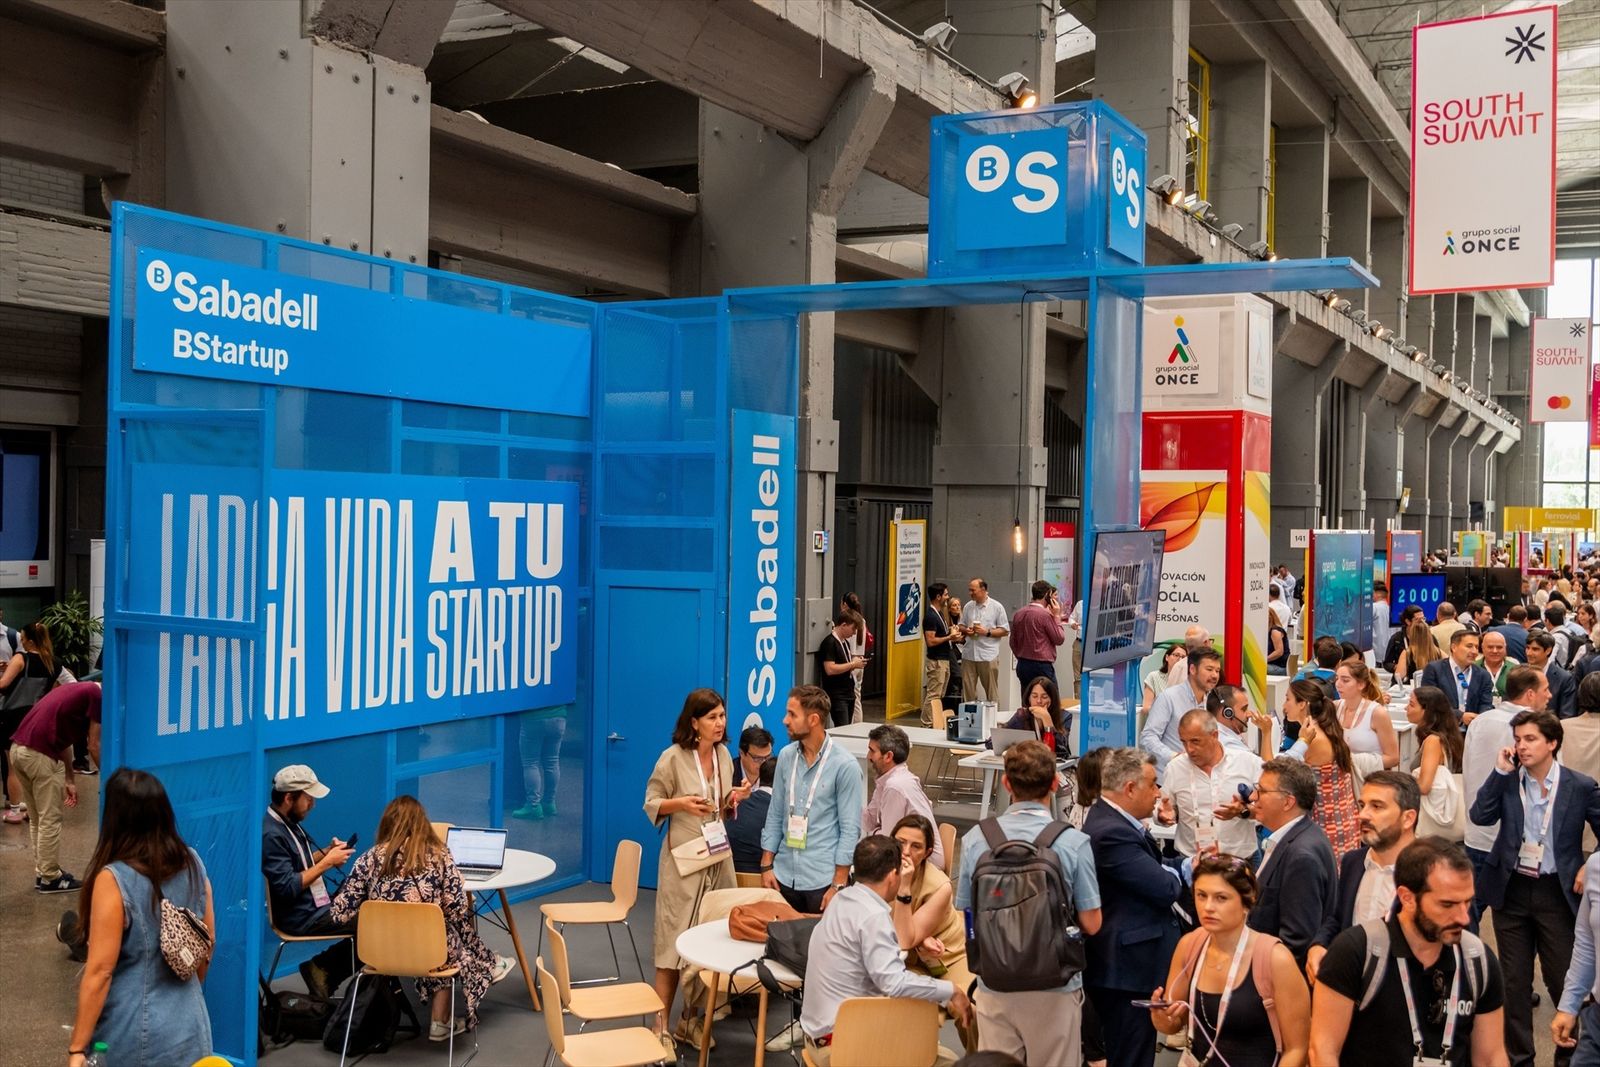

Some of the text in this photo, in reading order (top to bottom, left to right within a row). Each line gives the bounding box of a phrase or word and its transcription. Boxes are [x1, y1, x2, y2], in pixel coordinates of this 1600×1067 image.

[1423, 91, 1524, 123] SOUTH
[1423, 112, 1544, 146] SUMMIT
[1461, 224, 1521, 240] grupo social
[1461, 236, 1520, 254] ONCE
[172, 271, 318, 332] Sabadell
[173, 328, 289, 376] BStartup
[1536, 347, 1577, 357] SOUTH
[1155, 364, 1200, 374] grupo social
[1536, 356, 1585, 366] SUMMIT
[1155, 373, 1199, 385] ONCE
[428, 500, 564, 584] A TU
[747, 434, 780, 707] Sabadell
[1161, 572, 1206, 581] OVACIÓN
[1158, 590, 1200, 603] OCIAL
[1398, 588, 1439, 603] 2000
[325, 497, 414, 714] VIDA
[1156, 613, 1199, 623] ERSONAS
[426, 584, 563, 700] STARTUP
